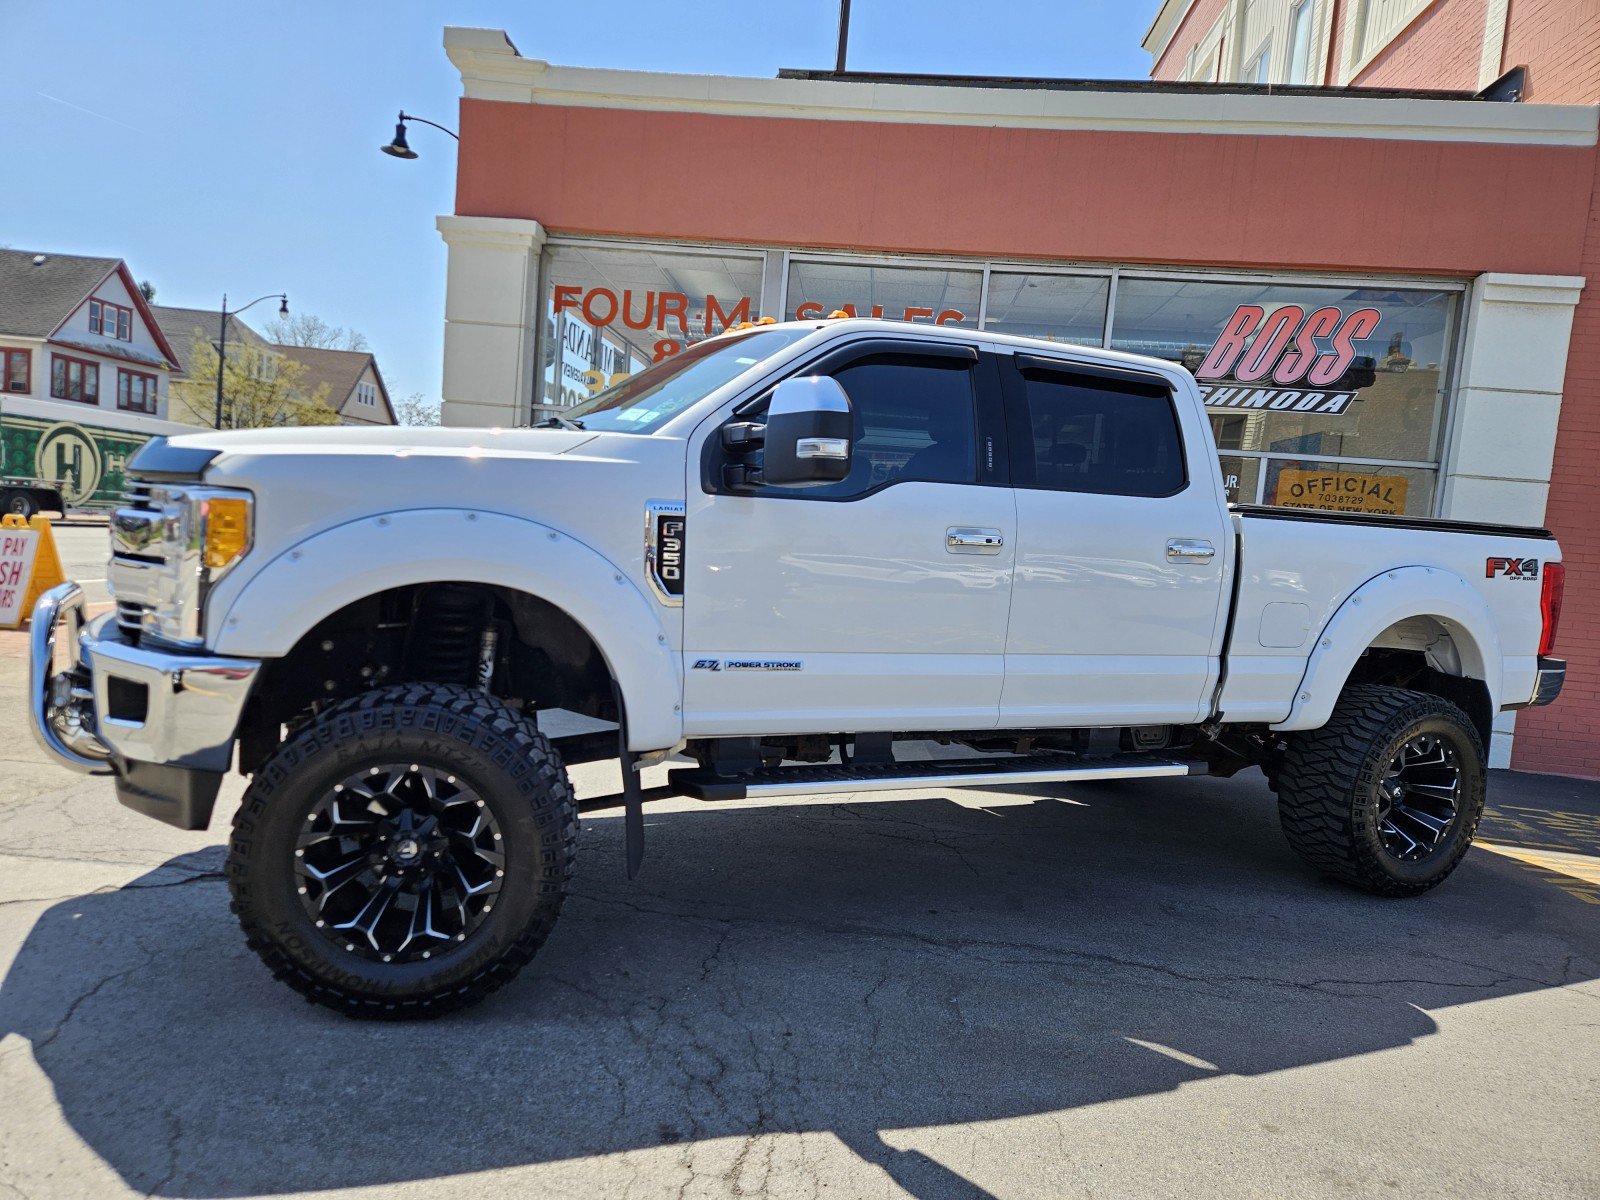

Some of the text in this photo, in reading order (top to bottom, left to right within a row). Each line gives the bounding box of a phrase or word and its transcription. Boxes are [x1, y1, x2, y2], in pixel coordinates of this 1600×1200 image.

[1194, 304, 1382, 387] BOSS
[1290, 477, 1395, 504] OFFICIAL
[1318, 493, 1364, 504] 7038729
[2, 537, 28, 557] PAY
[663, 521, 683, 580] F350
[1485, 556, 1539, 579] FX4
[763, 661, 802, 669] STROKE
